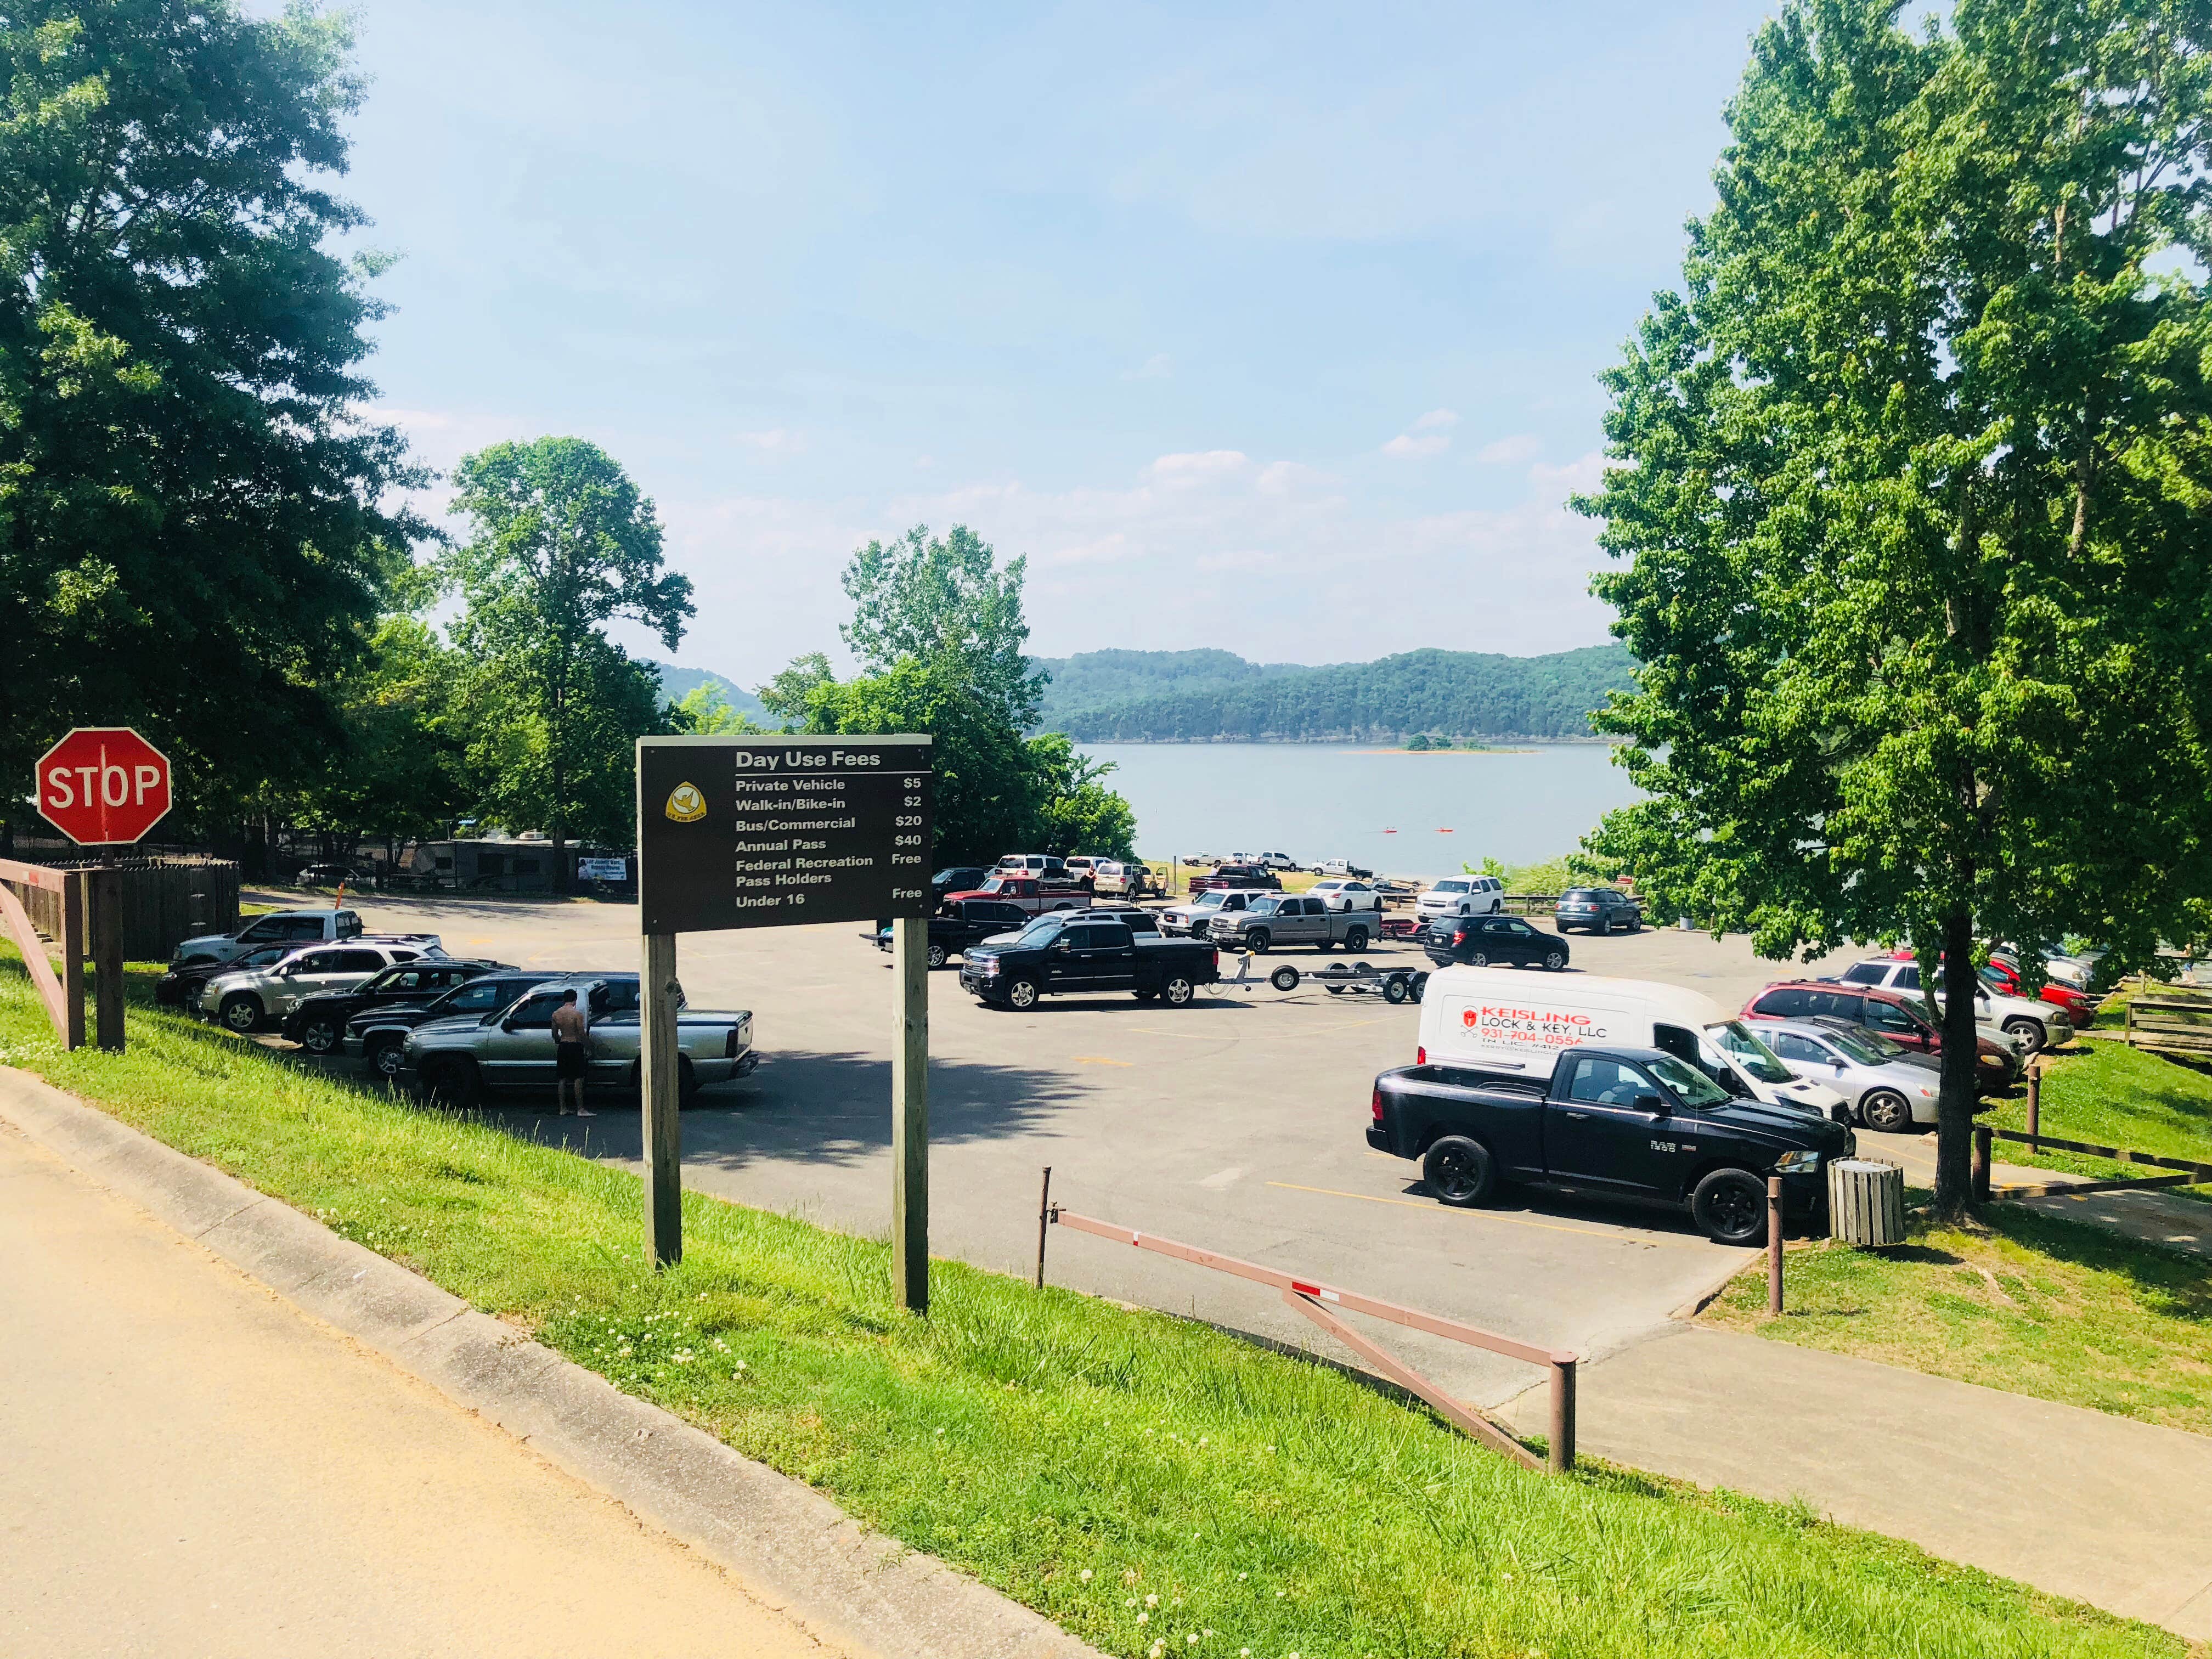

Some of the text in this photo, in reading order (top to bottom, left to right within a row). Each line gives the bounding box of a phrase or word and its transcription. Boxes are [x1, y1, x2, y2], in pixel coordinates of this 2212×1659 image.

[736, 751, 881, 771] Day Use Fees
[48, 765, 160, 809] STOP
[736, 777, 921, 792] Private Vehicle $5
[736, 795, 922, 811] Walk-in/Bike-in $2
[736, 815, 922, 832] Bus/Commercial $20
[735, 834, 922, 852] Annual Pass $40
[736, 854, 922, 872] Federal Recreation Free
[736, 873, 832, 887] Pass Holders
[736, 888, 922, 908] Under 16 Free
[1481, 1006, 1591, 1025] KEISLING
[1481, 1017, 1607, 1038] LOCK & KEY, LLC
